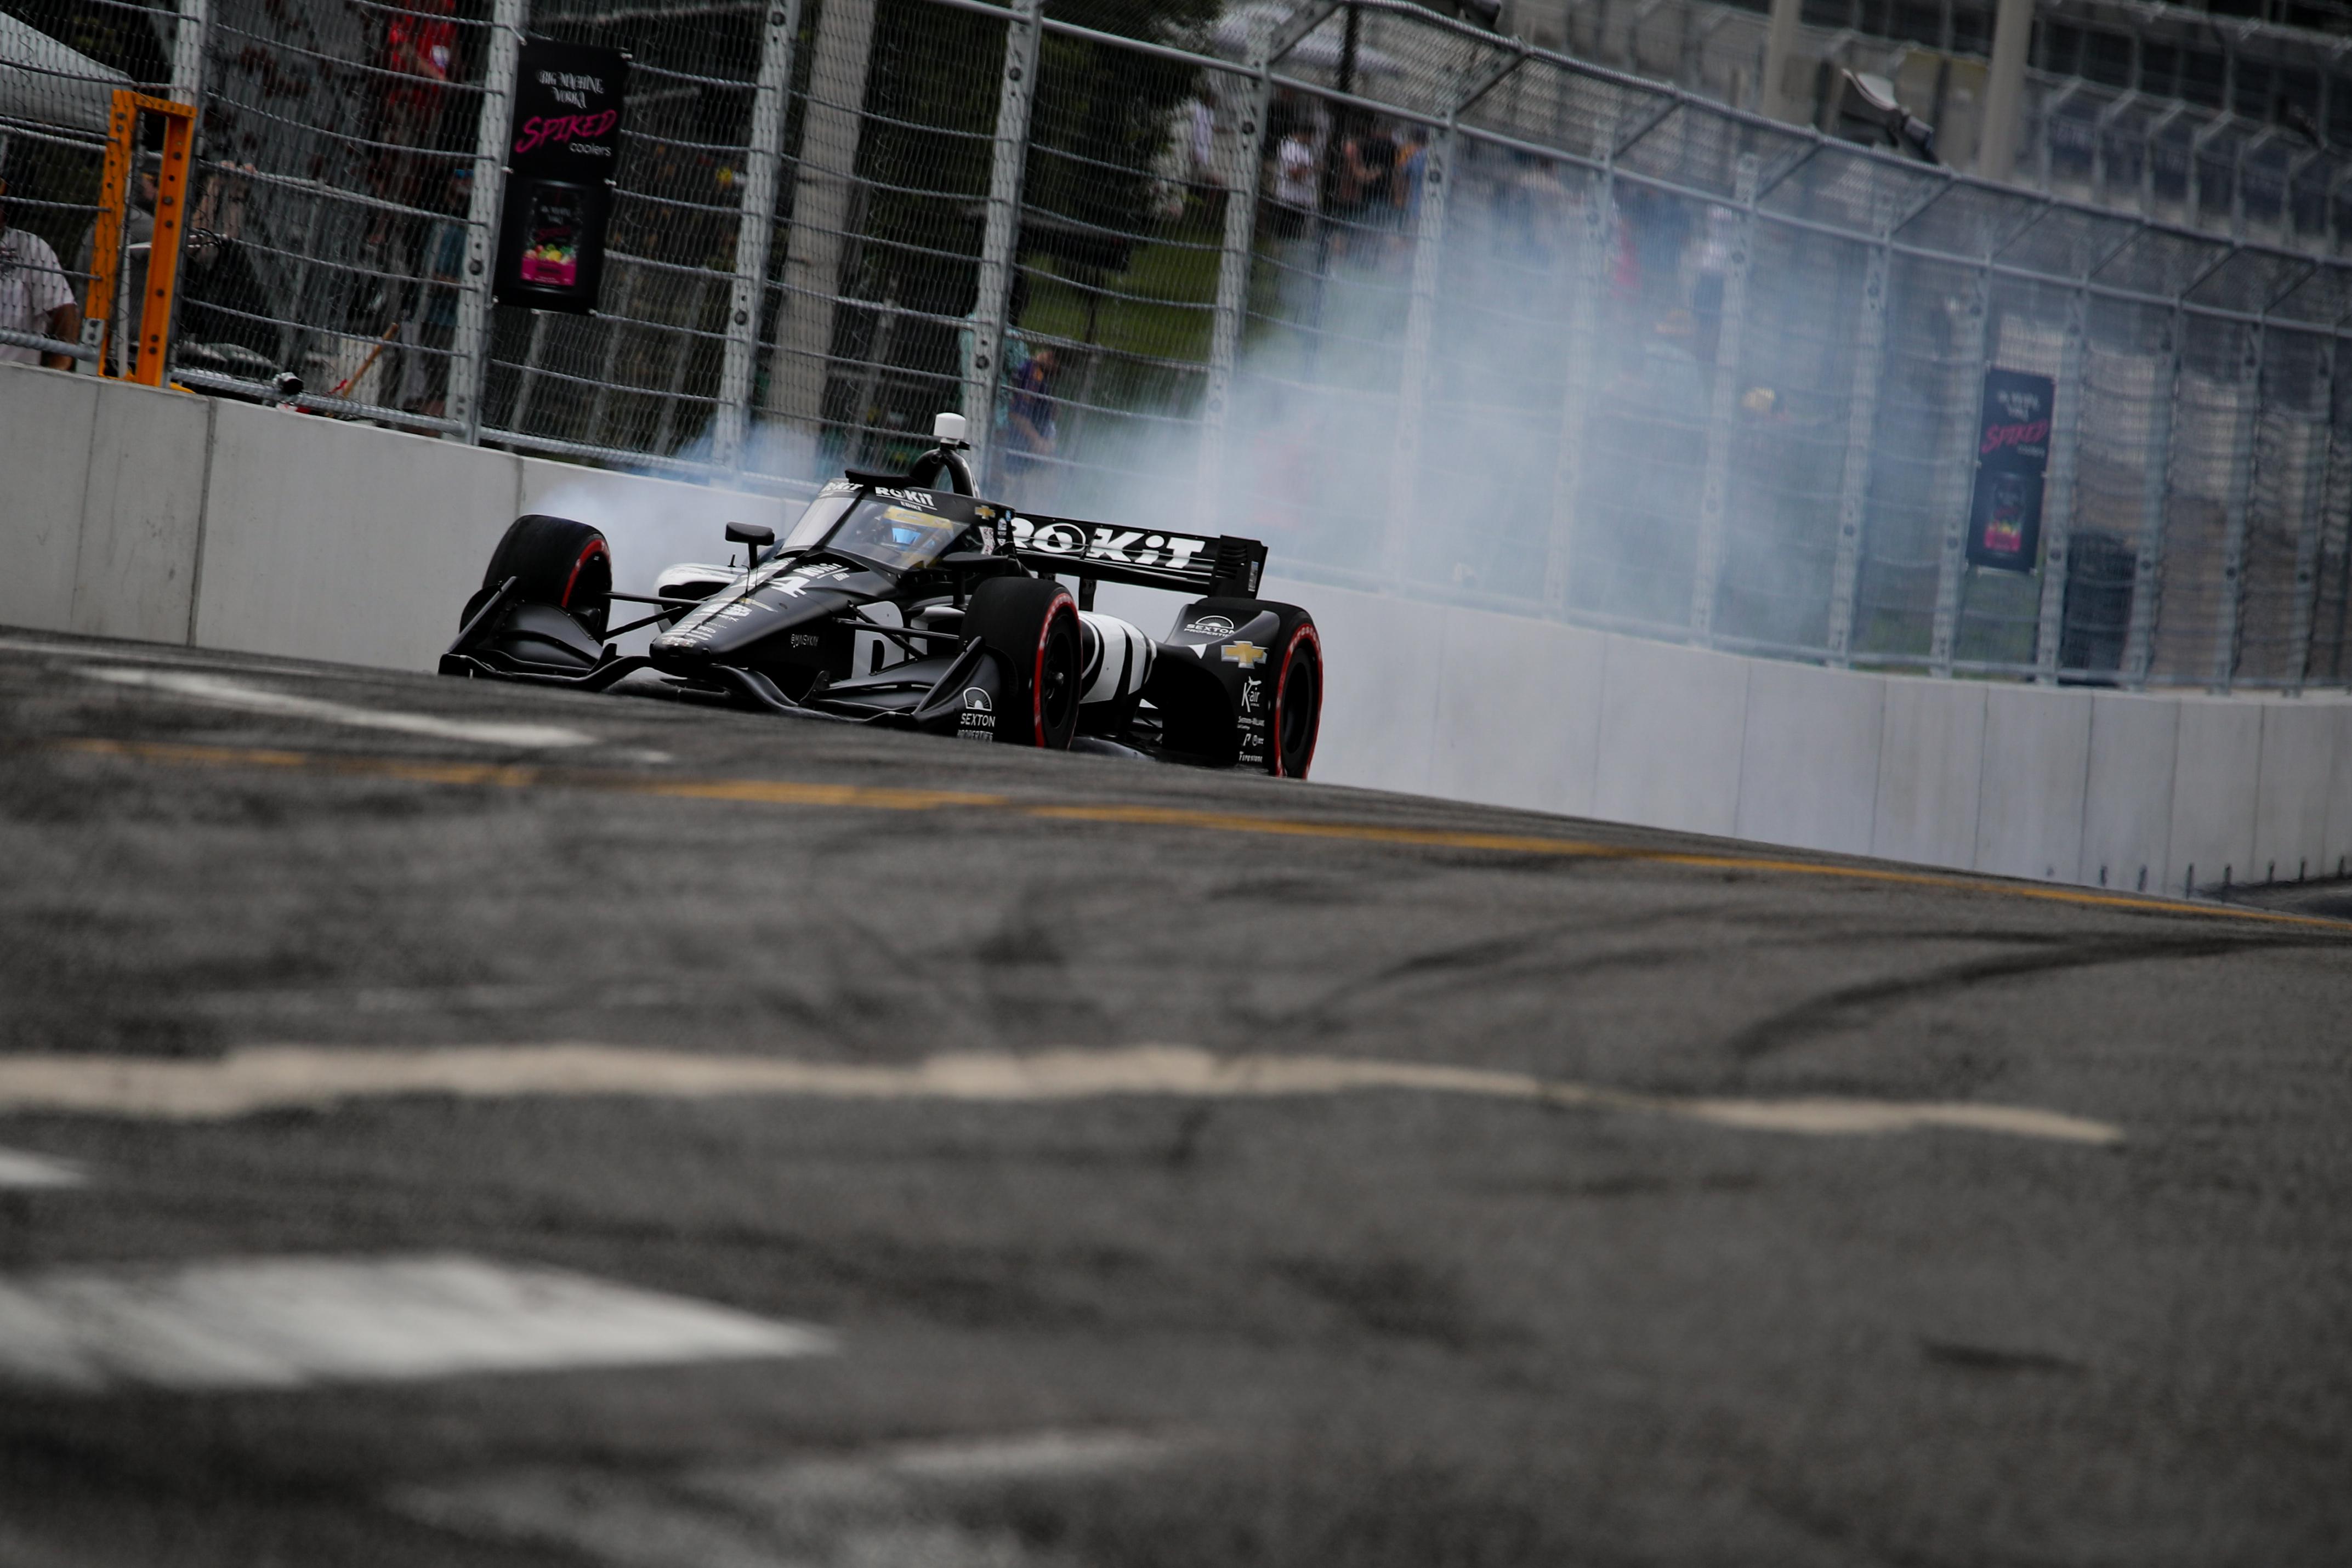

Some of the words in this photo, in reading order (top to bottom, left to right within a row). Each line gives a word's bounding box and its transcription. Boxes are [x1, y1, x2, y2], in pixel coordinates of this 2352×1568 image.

[537, 70, 557, 85] BIG
[514, 109, 618, 154] SPIKED
[569, 141, 613, 157] coolers
[875, 486, 934, 507] ROKiT
[1184, 628, 1230, 638] PROPERTI
[1186, 623, 1235, 634] SEXTON
[960, 712, 996, 728] SEXTON
